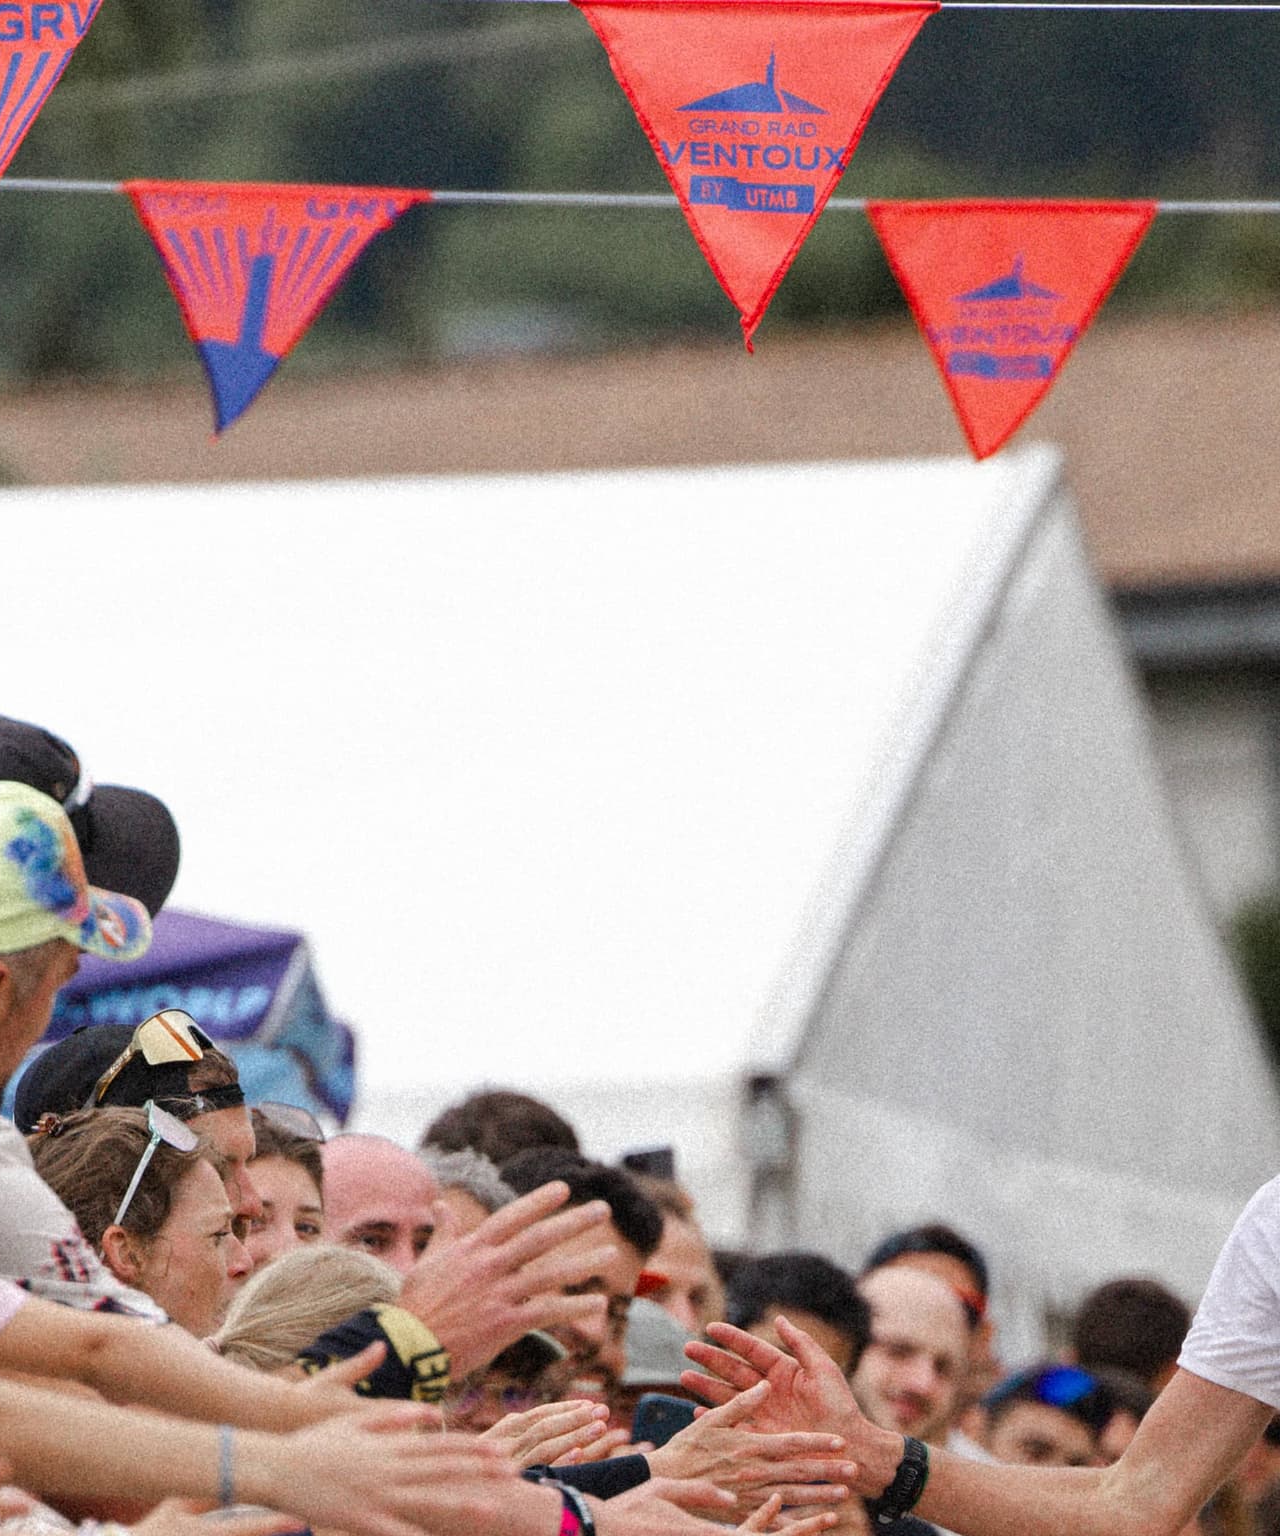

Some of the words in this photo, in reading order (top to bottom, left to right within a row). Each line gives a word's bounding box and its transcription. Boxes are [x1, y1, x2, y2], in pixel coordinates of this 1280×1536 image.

[688, 118, 760, 137] GRAND
[767, 120, 818, 138] RAID
[659, 141, 848, 172] VENTOUX
[700, 180, 724, 201] BY
[745, 187, 799, 209] UTMB
